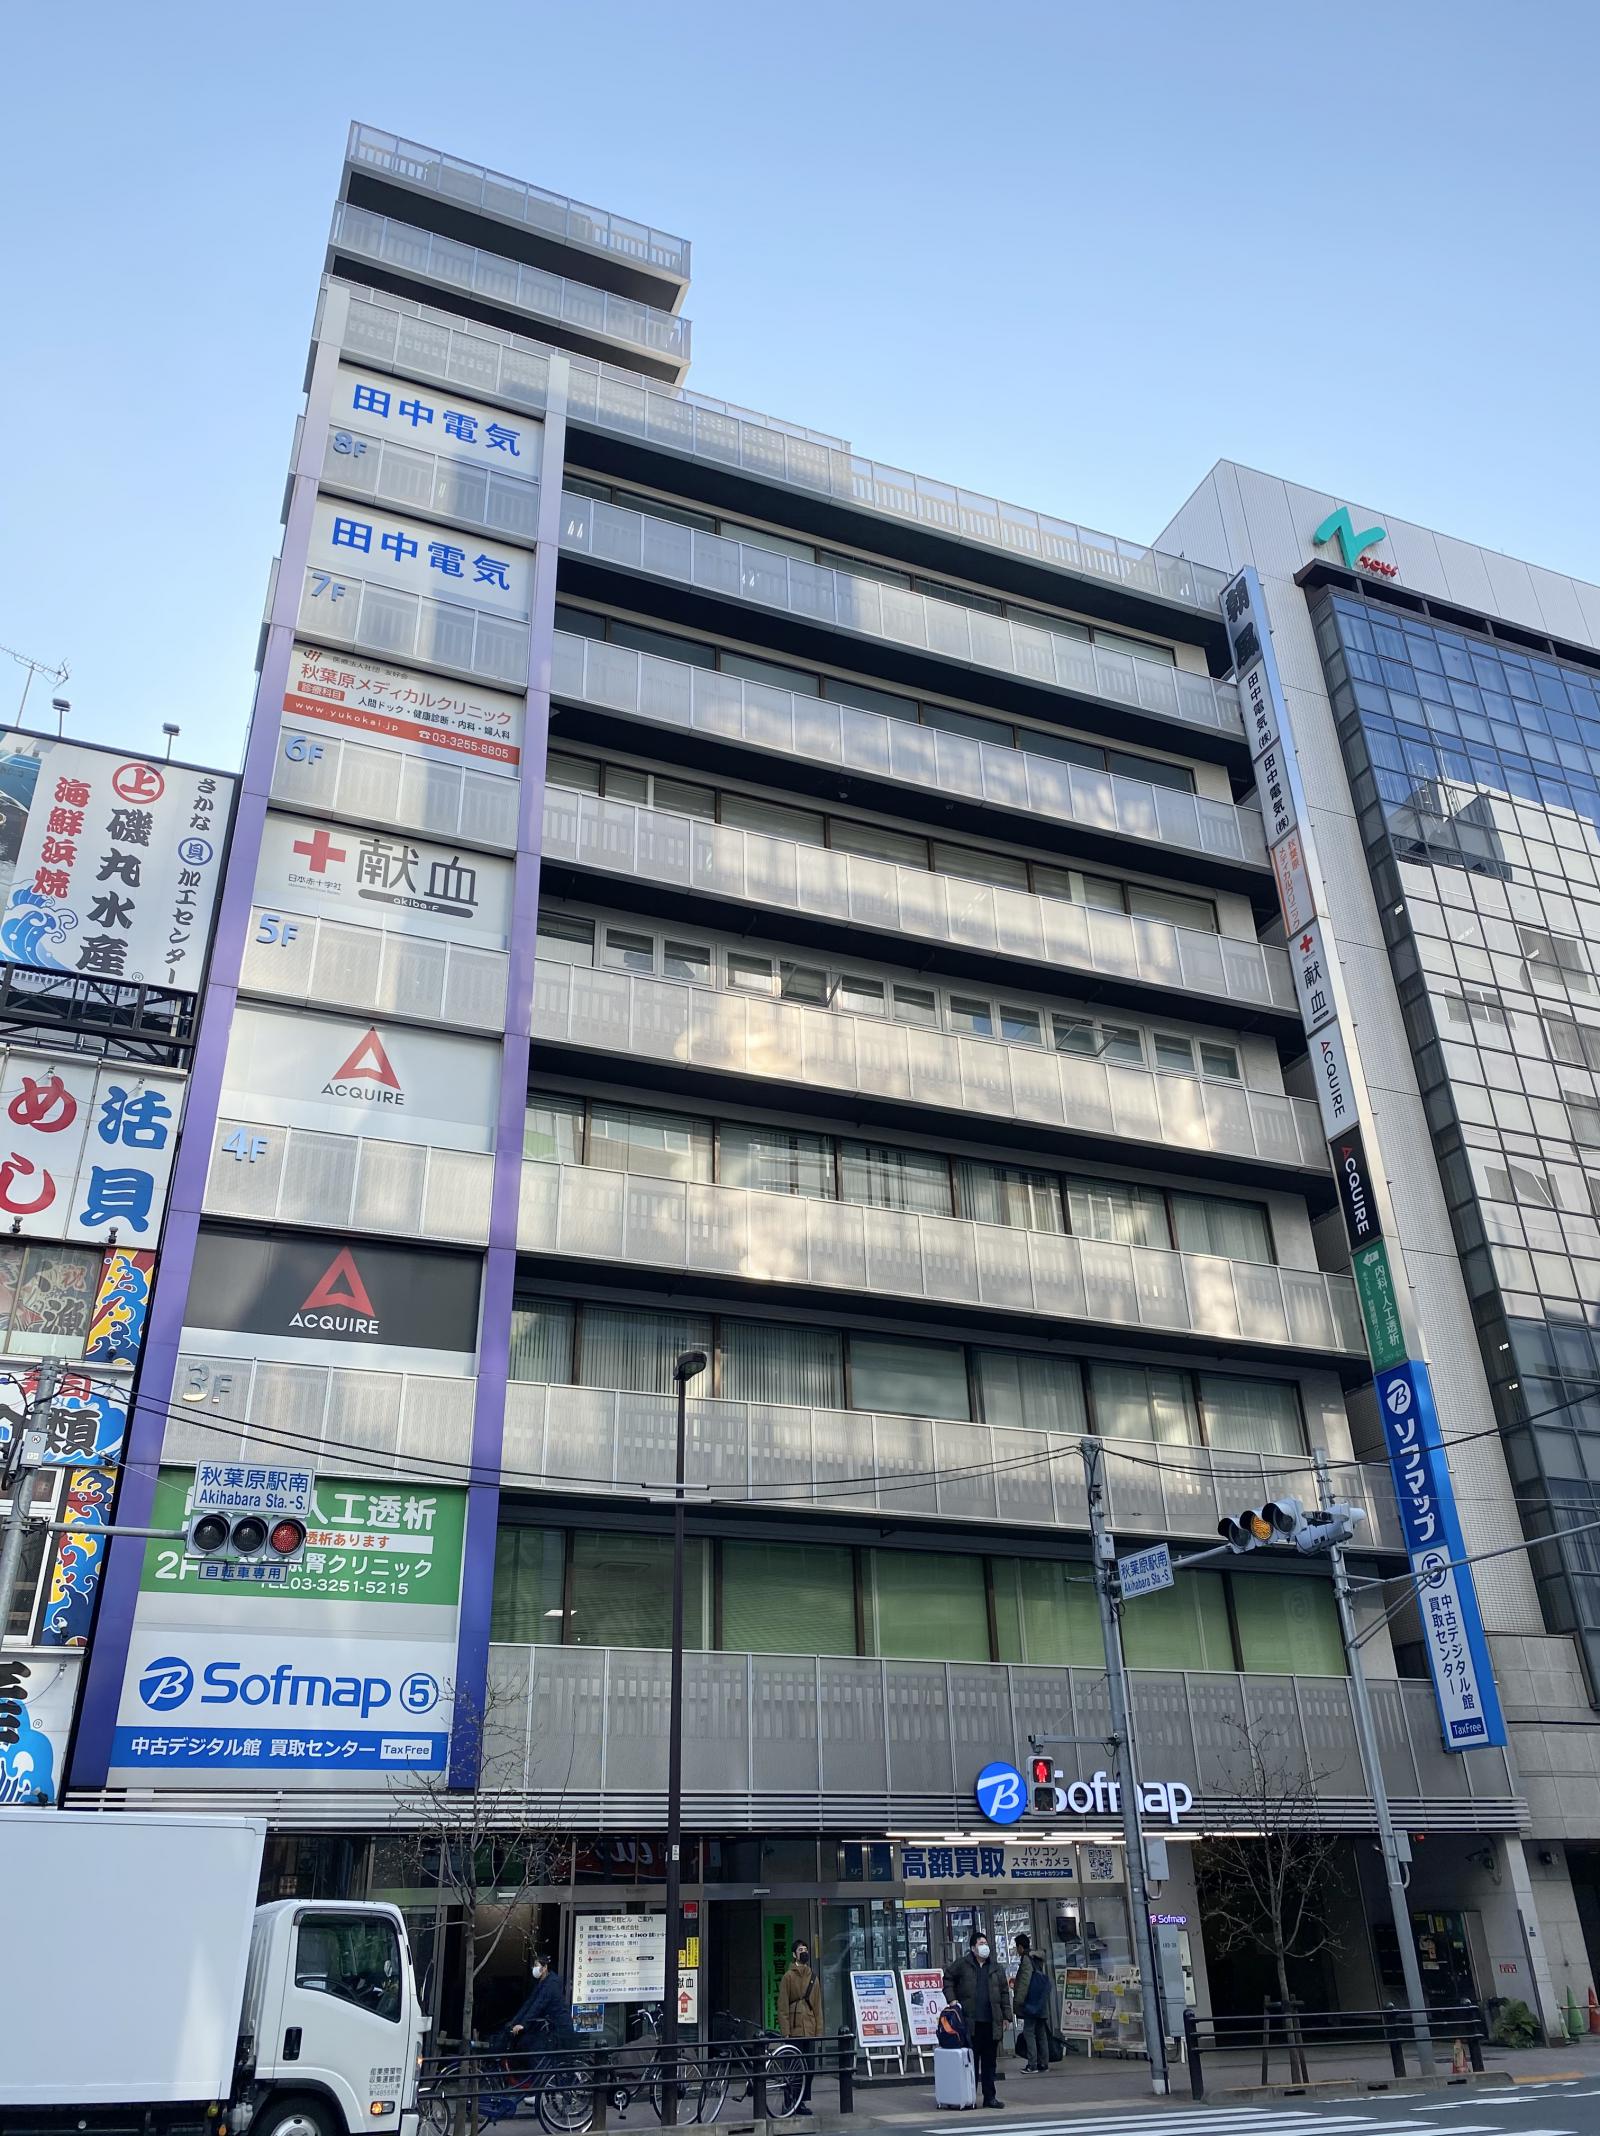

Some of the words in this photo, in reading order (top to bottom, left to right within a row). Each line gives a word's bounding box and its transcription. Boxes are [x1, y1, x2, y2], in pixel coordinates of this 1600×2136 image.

[353, 384, 521, 457] 田中電気
[332, 432, 368, 458] 8F
[332, 516, 511, 591] 田中電気
[311, 573, 346, 602] 7F
[301, 663, 512, 726] 秋葉原メディカルクリニック
[294, 701, 399, 732] www.yukokai.jp
[283, 735, 324, 765] 6F
[432, 731, 509, 759] 03-3255-8805
[31, 776, 92, 898] 海鮮浜焼
[355, 838, 479, 907] 献血
[75, 808, 154, 977] 磯丸水産
[256, 913, 299, 948] 5F
[1303, 960, 1327, 1015] 献血
[321, 1082, 405, 1105] ACQUIRE
[1320, 1040, 1346, 1119] ACQUIRE
[0, 1075, 77, 1215] めし
[79, 1085, 173, 1233] 活貝
[222, 1127, 270, 1163] 4F
[1342, 1146, 1370, 1236] ACQUIRE
[288, 1312, 381, 1335] ACQUIRE
[182, 1363, 232, 1403] 3F
[200, 1465, 309, 1494] 秋葉原駅南
[1394, 1417, 1436, 1543] ソフマップ
[200, 1490, 261, 1508] Akihabara
[205, 1565, 282, 1580] 自転車専用
[1120, 1550, 1168, 1580] 秋葉原駅南
[1428, 1597, 1456, 1696] 買取センター
[1441, 1594, 1475, 1710] 中古デジタル館
[201, 1662, 392, 1719] Sofmap
[131, 1736, 261, 1757] 中古デジタル館
[269, 1739, 376, 1758] 買取センター
[902, 1847, 1006, 1879] 高額買取
[1012, 1857, 1071, 1868] スマホ・カメラ
[1024, 1847, 1060, 1857] パソコン
[1157, 1914, 1187, 1925] Sofmap
[861, 2010, 879, 2022] 200
